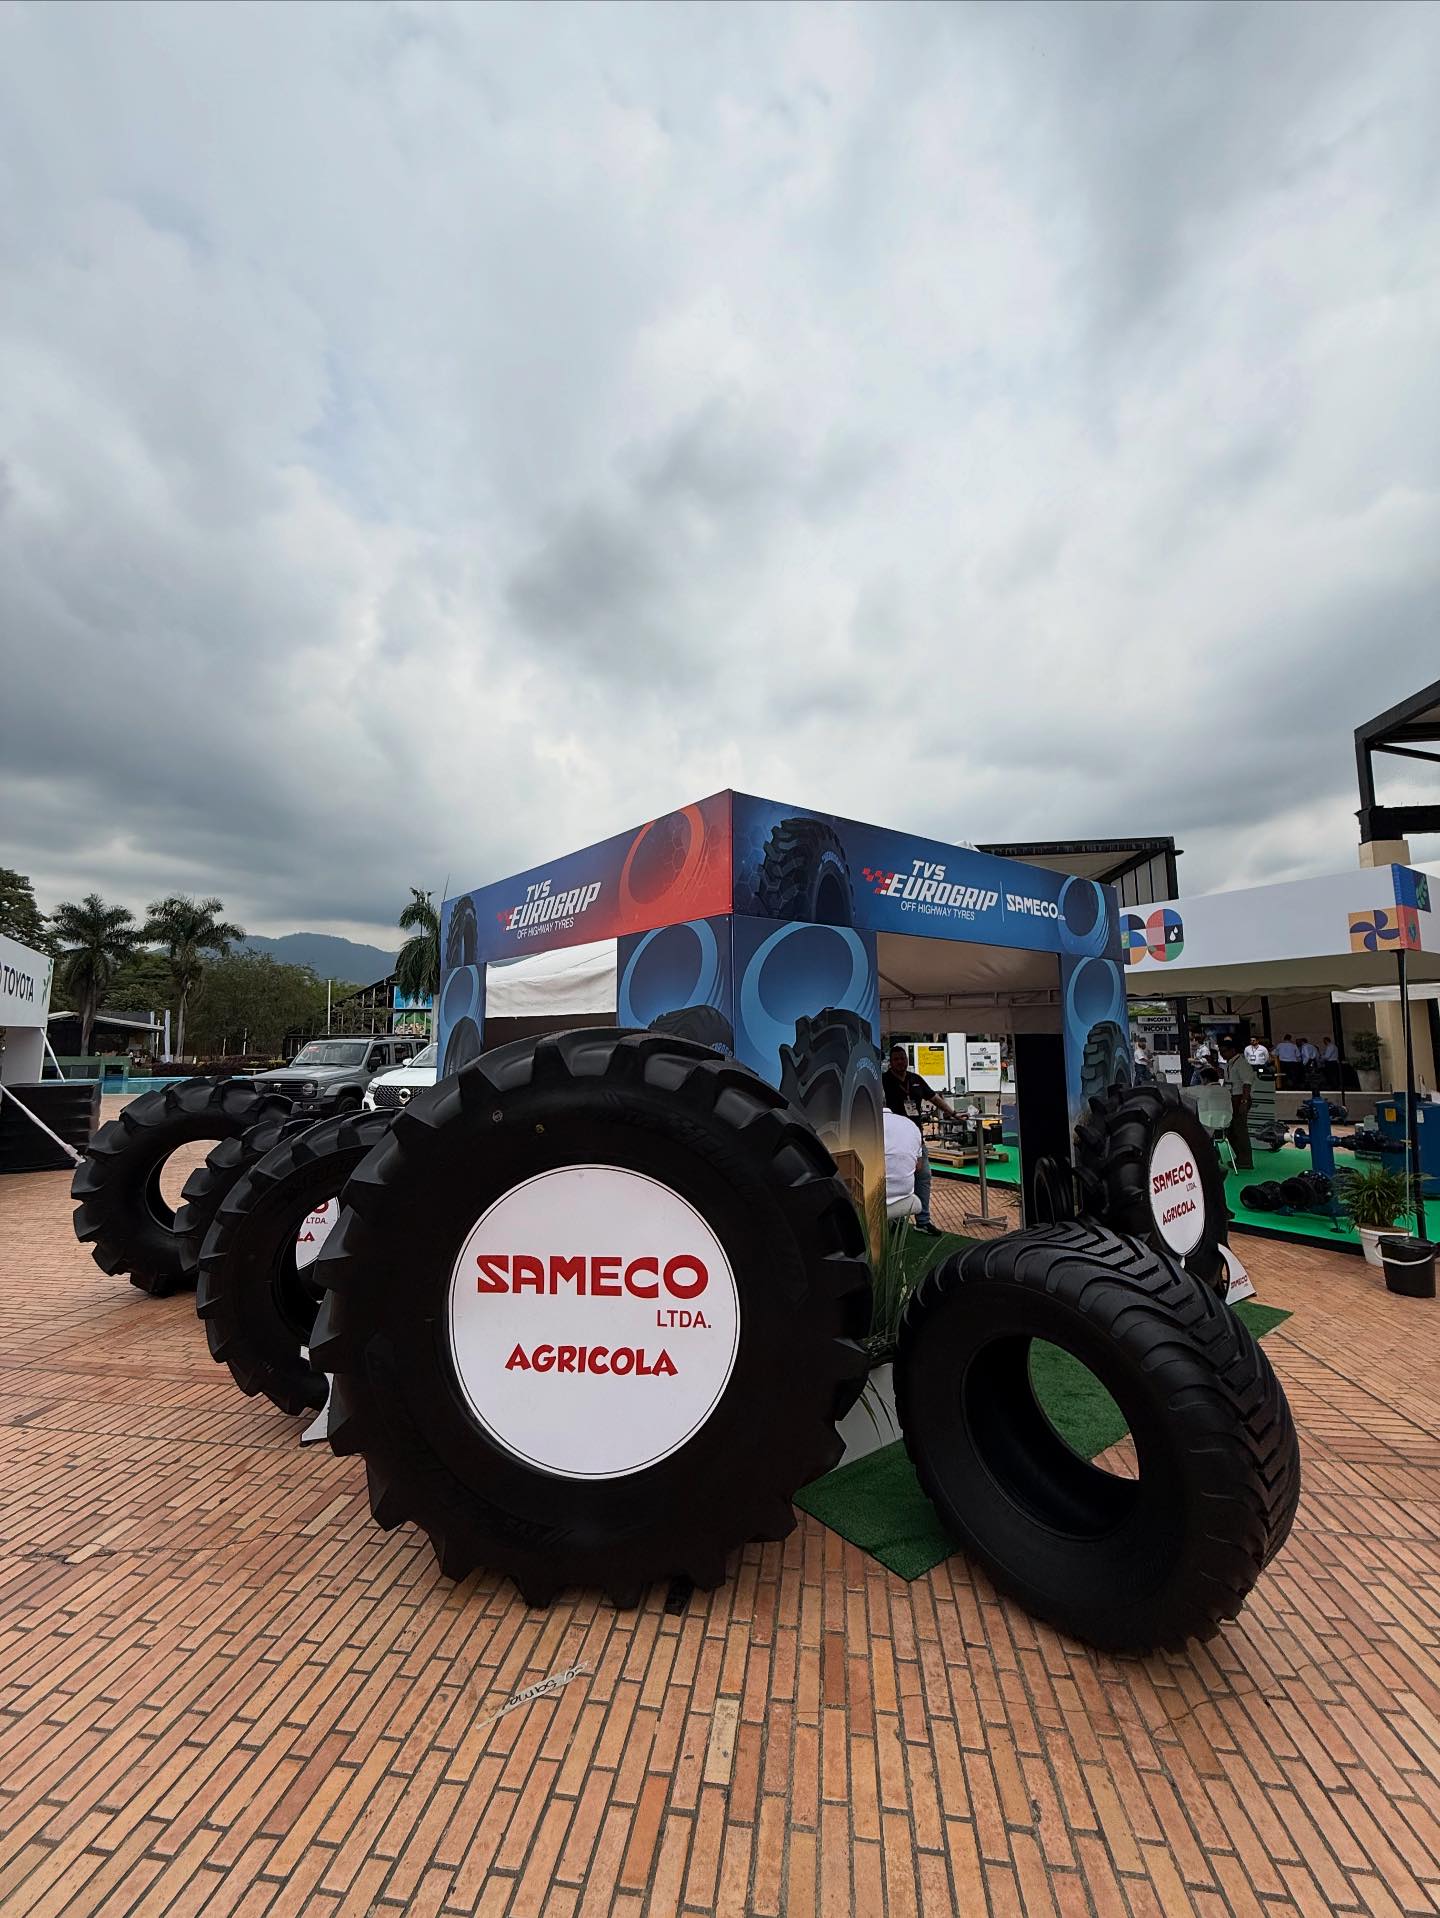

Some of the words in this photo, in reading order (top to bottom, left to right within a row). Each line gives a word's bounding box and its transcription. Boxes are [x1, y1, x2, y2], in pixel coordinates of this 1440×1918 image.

[912, 860, 946, 881] TVS
[526, 879, 552, 902] TVS
[887, 873, 998, 911] EUROGRIP
[509, 882, 601, 930] EUROGRIP
[900, 901, 917, 912] OFF
[917, 904, 952, 917] HIGHWAY
[953, 909, 975, 921] TYRES
[1006, 894, 1058, 919] SAMECO
[517, 928, 527, 939] OFF
[528, 921, 554, 937] HIGHWAY
[555, 917, 575, 930] TYRES
[4, 965, 34, 1003] TOYOTA
[1152, 1161, 1194, 1195] SAMECO
[1162, 1199, 1196, 1226] AGRICOLA
[477, 1254, 709, 1300] SAMECO
[656, 1309, 712, 1329] LTDA.
[505, 1343, 679, 1377] AGRICOLA
